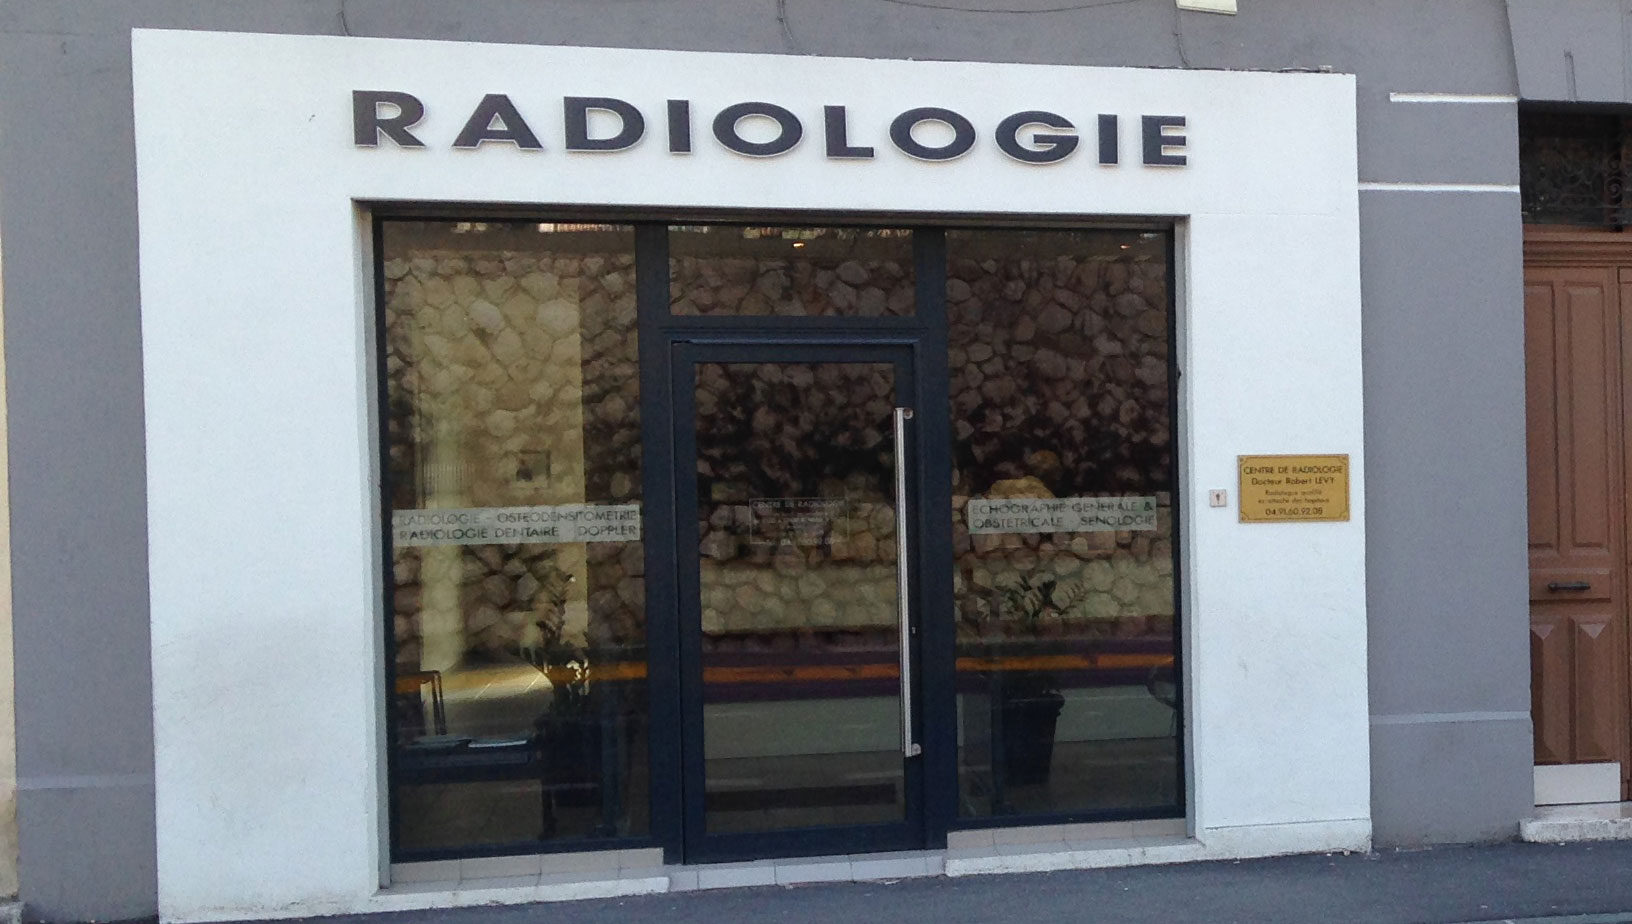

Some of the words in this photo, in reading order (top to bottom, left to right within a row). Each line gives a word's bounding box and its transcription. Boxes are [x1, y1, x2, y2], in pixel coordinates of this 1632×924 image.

[352, 89, 1191, 167] RADIOLOGIE
[1278, 466, 1289, 474] DE
[1292, 465, 1343, 474] RADIOLOGIE
[1251, 478, 1282, 486] Docteur
[1315, 477, 1335, 485] LEVY
[972, 503, 1066, 514] ECHOGRAPHIE
[1143, 501, 1153, 511] &
[399, 513, 482, 526] RADIOLOGIE
[497, 510, 637, 523] OSTEODENSITOMETRIE
[973, 517, 1064, 529] OBSTETRICALE
[1080, 514, 1155, 526] SENOLOGIE
[399, 527, 488, 540] RADIOLOGIE
[494, 526, 559, 538] DENTAIRE
[577, 525, 637, 537] DOPPLER
